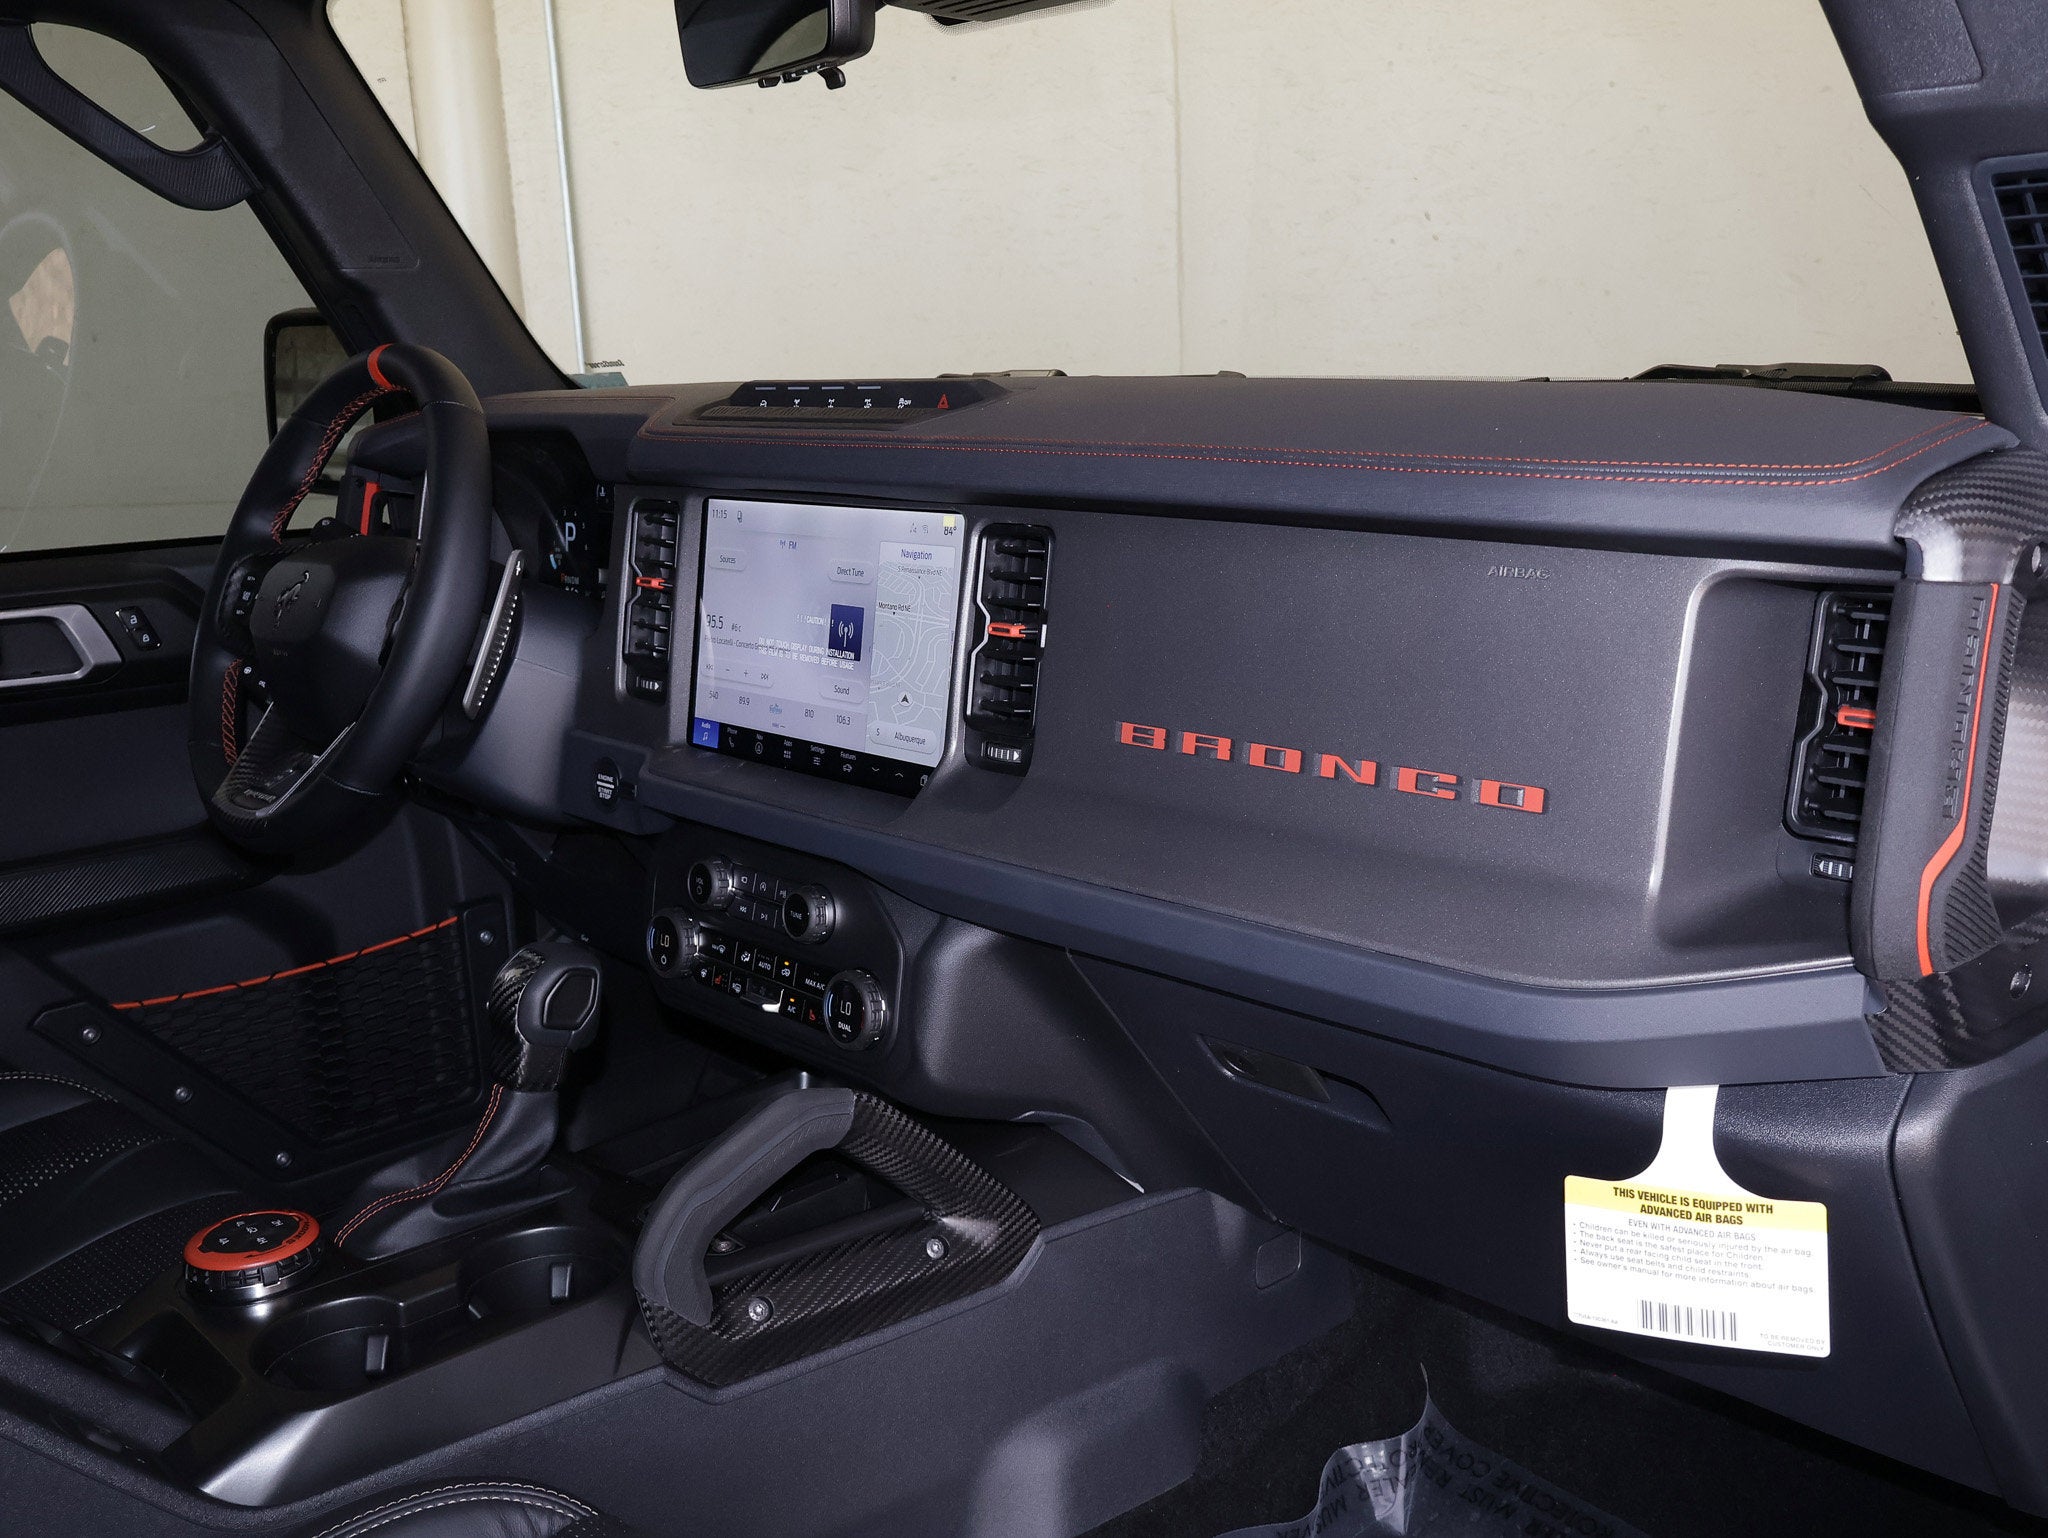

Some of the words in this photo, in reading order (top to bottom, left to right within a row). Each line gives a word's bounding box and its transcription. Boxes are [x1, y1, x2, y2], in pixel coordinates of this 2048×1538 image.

[712, 509, 728, 519] 11:15
[565, 521, 577, 553] P
[788, 540, 797, 550] FM
[719, 555, 736, 564] Sources
[900, 549, 933, 561] Navigation
[836, 566, 852, 576] Direct
[852, 567, 865, 578] Tune
[1487, 564, 1552, 580] AIRBAG
[706, 614, 724, 630] 95.5
[825, 648, 855, 660] INSTALLATION
[834, 685, 850, 695] Sound
[738, 695, 750, 706] 89.9
[804, 708, 815, 719] 810
[836, 714, 851, 726] 106.3
[894, 731, 926, 746] Albuquerque
[840, 750, 857, 761] Features
[1114, 721, 1546, 814] BRONCO
[597, 786, 613, 796] START
[599, 792, 612, 800] STOP
[790, 910, 803, 920] TUNE
[758, 961, 772, 971] AUTO
[804, 978, 816, 987] MAX
[816, 981, 826, 991] A/C
[787, 1005, 796, 1014] A/C
[840, 1000, 851, 1016] LO
[837, 1021, 852, 1033] DUAL
[1613, 1187, 1635, 1199] THIS
[1638, 1190, 1678, 1205] VEHICLE
[1680, 1196, 1690, 1207] IS
[1692, 1198, 1743, 1212] EQUIPPED
[1745, 1203, 1774, 1214] WITH
[1640, 1204, 1693, 1220] ADVANCED
[1695, 1212, 1712, 1223] AIR
[1715, 1214, 1743, 1225] BAGS
[1628, 1219, 1648, 1229] EVEN
[1650, 1222, 1671, 1232] WITH
[1673, 1225, 1715, 1238] ADVANCED
[1717, 1231, 1731, 1239] AIR
[1734, 1232, 1756, 1241] BAGS
[1579, 1221, 1613, 1233] Children
[1614, 1228, 1629, 1236] can
[1631, 1229, 1641, 1237] be
[1643, 1231, 1665, 1241] killed
[1678, 1237, 1716, 1250] seriously
[1718, 1241, 1749, 1251] injured
[1751, 1244, 1761, 1253] by
[1764, 1245, 1778, 1253] the
[1780, 1247, 1792, 1255] air
[1579, 1230, 1594, 1239] The
[1596, 1231, 1615, 1242] back
[1617, 1236, 1634, 1246] seat
[1636, 1239, 1643, 1247] is
[1645, 1240, 1658, 1249] the
[1660, 1242, 1685, 1253] safest
[1687, 1245, 1710, 1257] place
[1712, 1249, 1724, 1257] for
[1579, 1239, 1602, 1249] Never
[1604, 1243, 1618, 1253] put
[1626, 1247, 1642, 1256] rear
[1644, 1249, 1669, 1261] facing
[1671, 1253, 1692, 1263] child
[1694, 1256, 1712, 1265] seat
[1714, 1258, 1722, 1266] in
[1724, 1260, 1738, 1269] the
[1580, 1248, 1608, 1260] Always
[1610, 1253, 1625, 1262] use
[1626, 1255, 1644, 1265] seat
[1646, 1257, 1666, 1268] belts
[1667, 1260, 1683, 1270] and
[1685, 1263, 1706, 1274] child
[1580, 1257, 1595, 1266] See
[1630, 1265, 1660, 1276] manual
[1661, 1269, 1673, 1278] for
[1675, 1273, 1697, 1282] more
[1699, 1275, 1748, 1288] information
[1750, 1281, 1776, 1290] about
[1777, 1283, 1790, 1291] air
